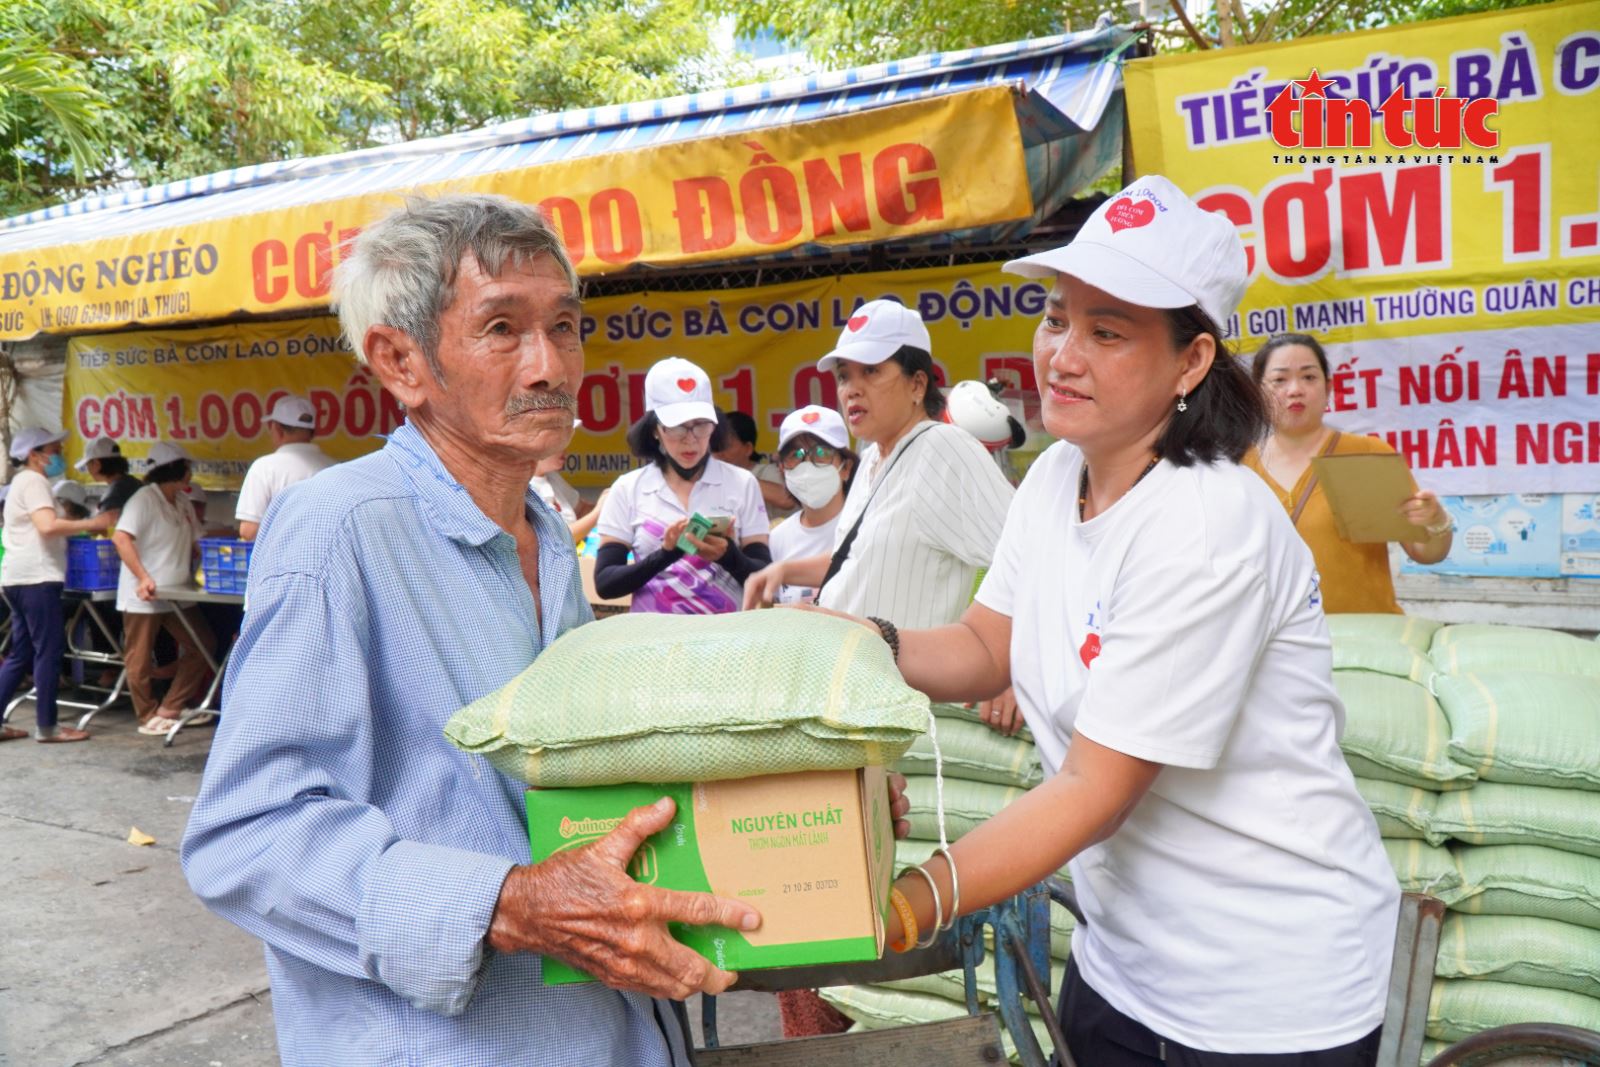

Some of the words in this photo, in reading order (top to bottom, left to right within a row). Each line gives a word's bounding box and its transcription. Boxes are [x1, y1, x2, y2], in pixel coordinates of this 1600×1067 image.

[1456, 36, 1537, 104] BÀ
[672, 141, 945, 254] ĐỒNG
[2, 261, 85, 306] ĐỘNG
[96, 239, 219, 290] NGHÈO
[607, 305, 673, 341] SỨC
[683, 300, 729, 337] BÀ
[739, 300, 820, 333] CON
[918, 280, 1048, 329] ĐỘNG
[1250, 308, 1286, 339] GỌI
[1295, 299, 1364, 332] MẠNH
[1374, 289, 1474, 321] THƯỜNG
[1485, 279, 1557, 312] QUÂN
[154, 344, 179, 363] BÀ
[186, 344, 228, 362] CON
[236, 339, 279, 359] LAO
[1325, 357, 1382, 412] ẾT
[1399, 346, 1480, 406] NỐI
[1498, 348, 1567, 399] ÂN
[79, 390, 157, 439] CƠM
[586, 454, 630, 474] MẠNH
[731, 811, 798, 834] NGUYÊN
